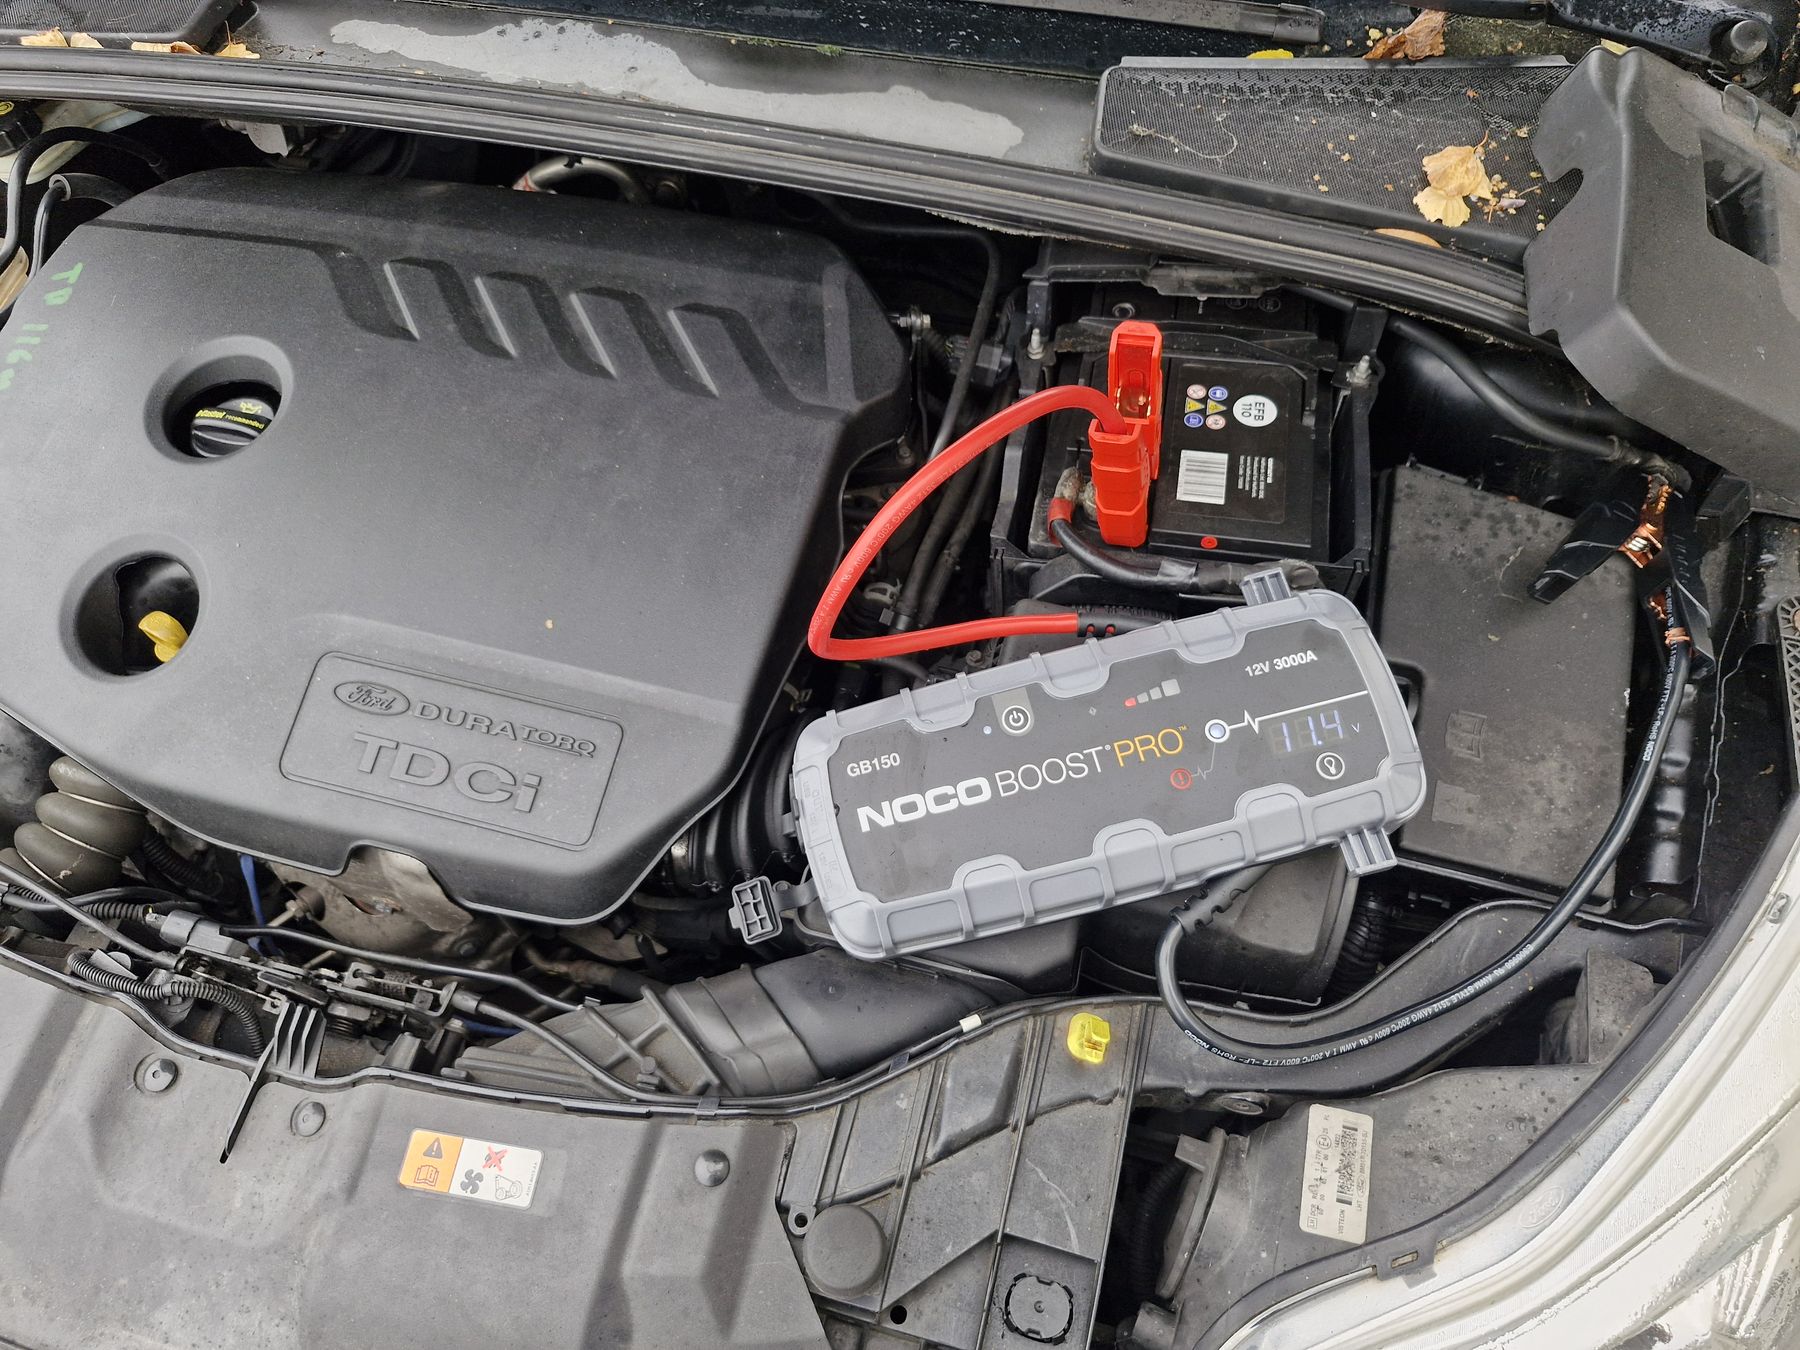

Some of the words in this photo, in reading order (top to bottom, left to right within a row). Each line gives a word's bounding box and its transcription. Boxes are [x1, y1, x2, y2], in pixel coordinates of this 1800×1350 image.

[1241, 403, 1252, 418] 110
[1253, 401, 1265, 421] EFB
[1244, 660, 1271, 677] 12V
[1273, 650, 1318, 671] 3000A
[412, 700, 598, 758] DURATORQ
[1281, 709, 1344, 753] 11.4
[1649, 720, 1660, 740] RoHS
[1642, 740, 1655, 761] NOCO
[353, 731, 543, 814] TDCi
[846, 752, 901, 777] GB150
[856, 776, 993, 833] NOCO
[1475, 975, 1493, 989] AWM
[1452, 985, 1475, 1003] STYLE
[1412, 1008, 1433, 1022] 4AWG
[1434, 1000, 1451, 1012] 3512
[1184, 1029, 1210, 1050] NOCO
[1374, 1026, 1391, 1040] 600V
[1211, 1047, 1237, 1061] RoHS
[1339, 1041, 1357, 1053] AWM
[1279, 1056, 1301, 1066] 600V
